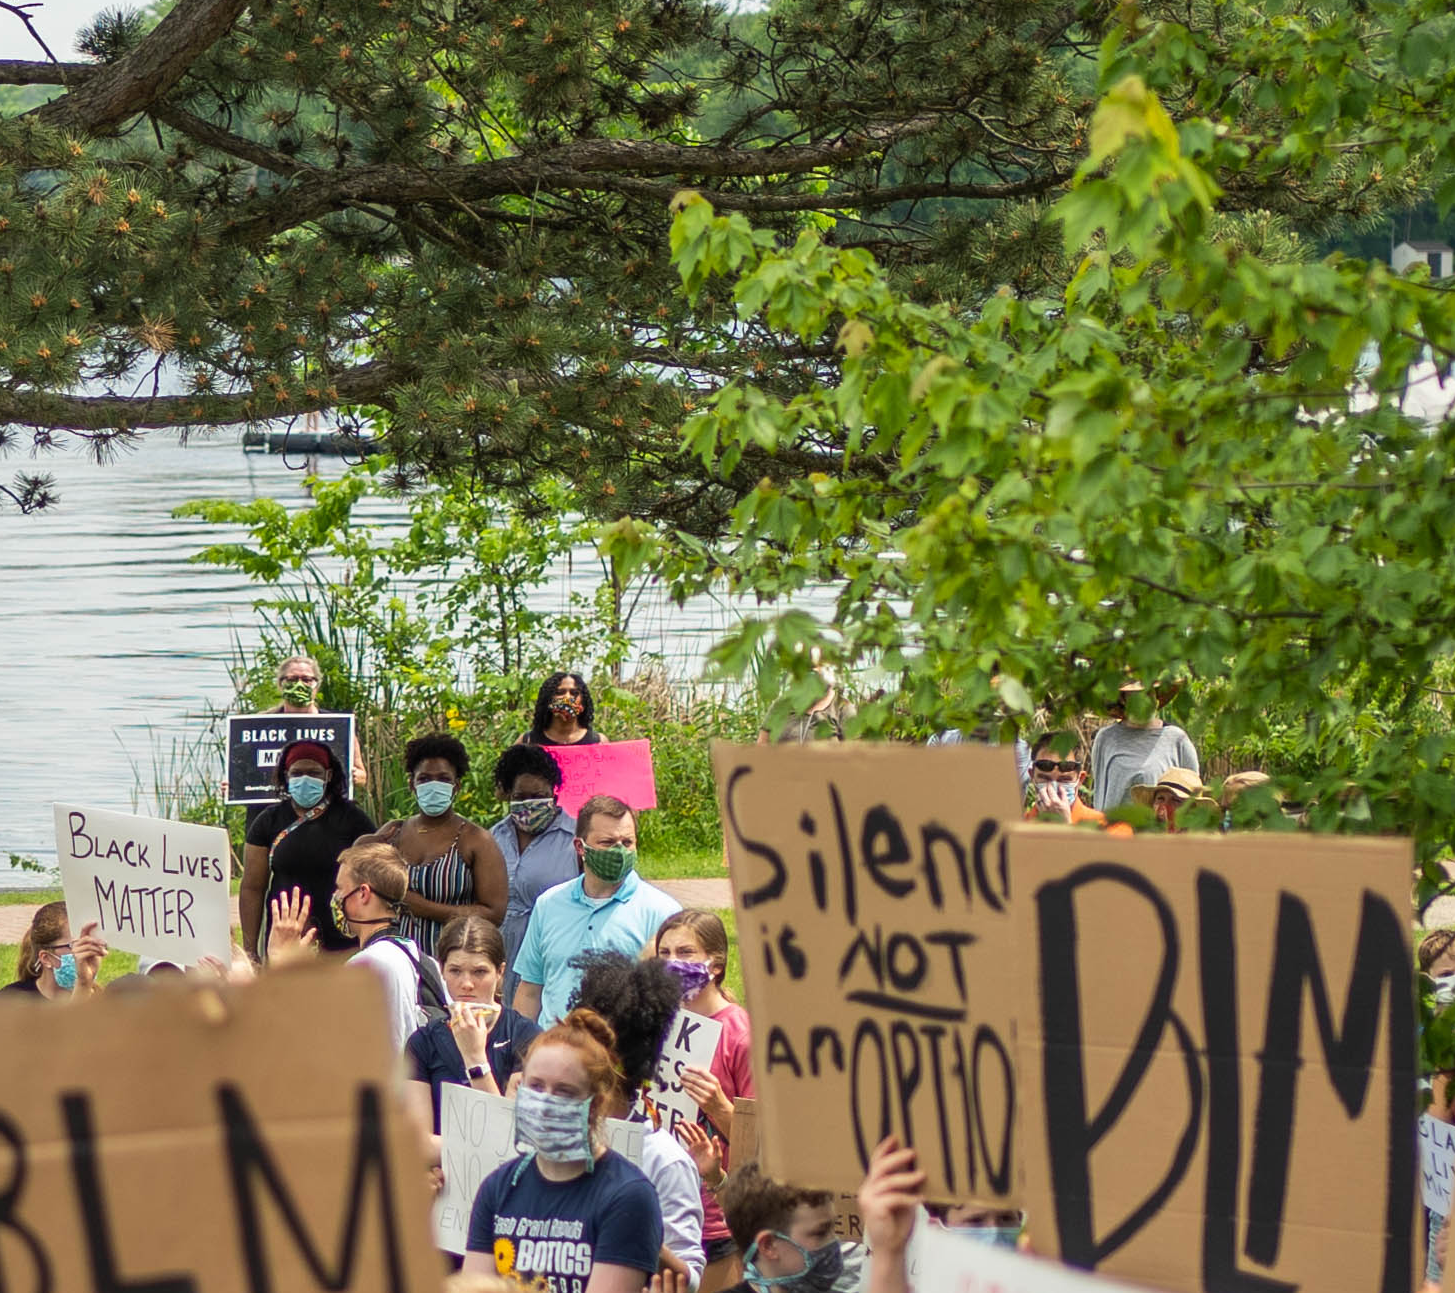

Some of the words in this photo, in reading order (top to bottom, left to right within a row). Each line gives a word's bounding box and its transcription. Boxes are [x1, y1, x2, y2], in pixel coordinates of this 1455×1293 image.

[242, 728, 287, 743] BLACK
[296, 727, 336, 741] LIVES
[94, 875, 196, 939] MATTER
[761, 921, 808, 981] is
[838, 921, 979, 1004] NOT
[448, 1093, 490, 1149] NO
[849, 1017, 1016, 1197] OPTIO
[515, 1238, 592, 1277] BOTICS
